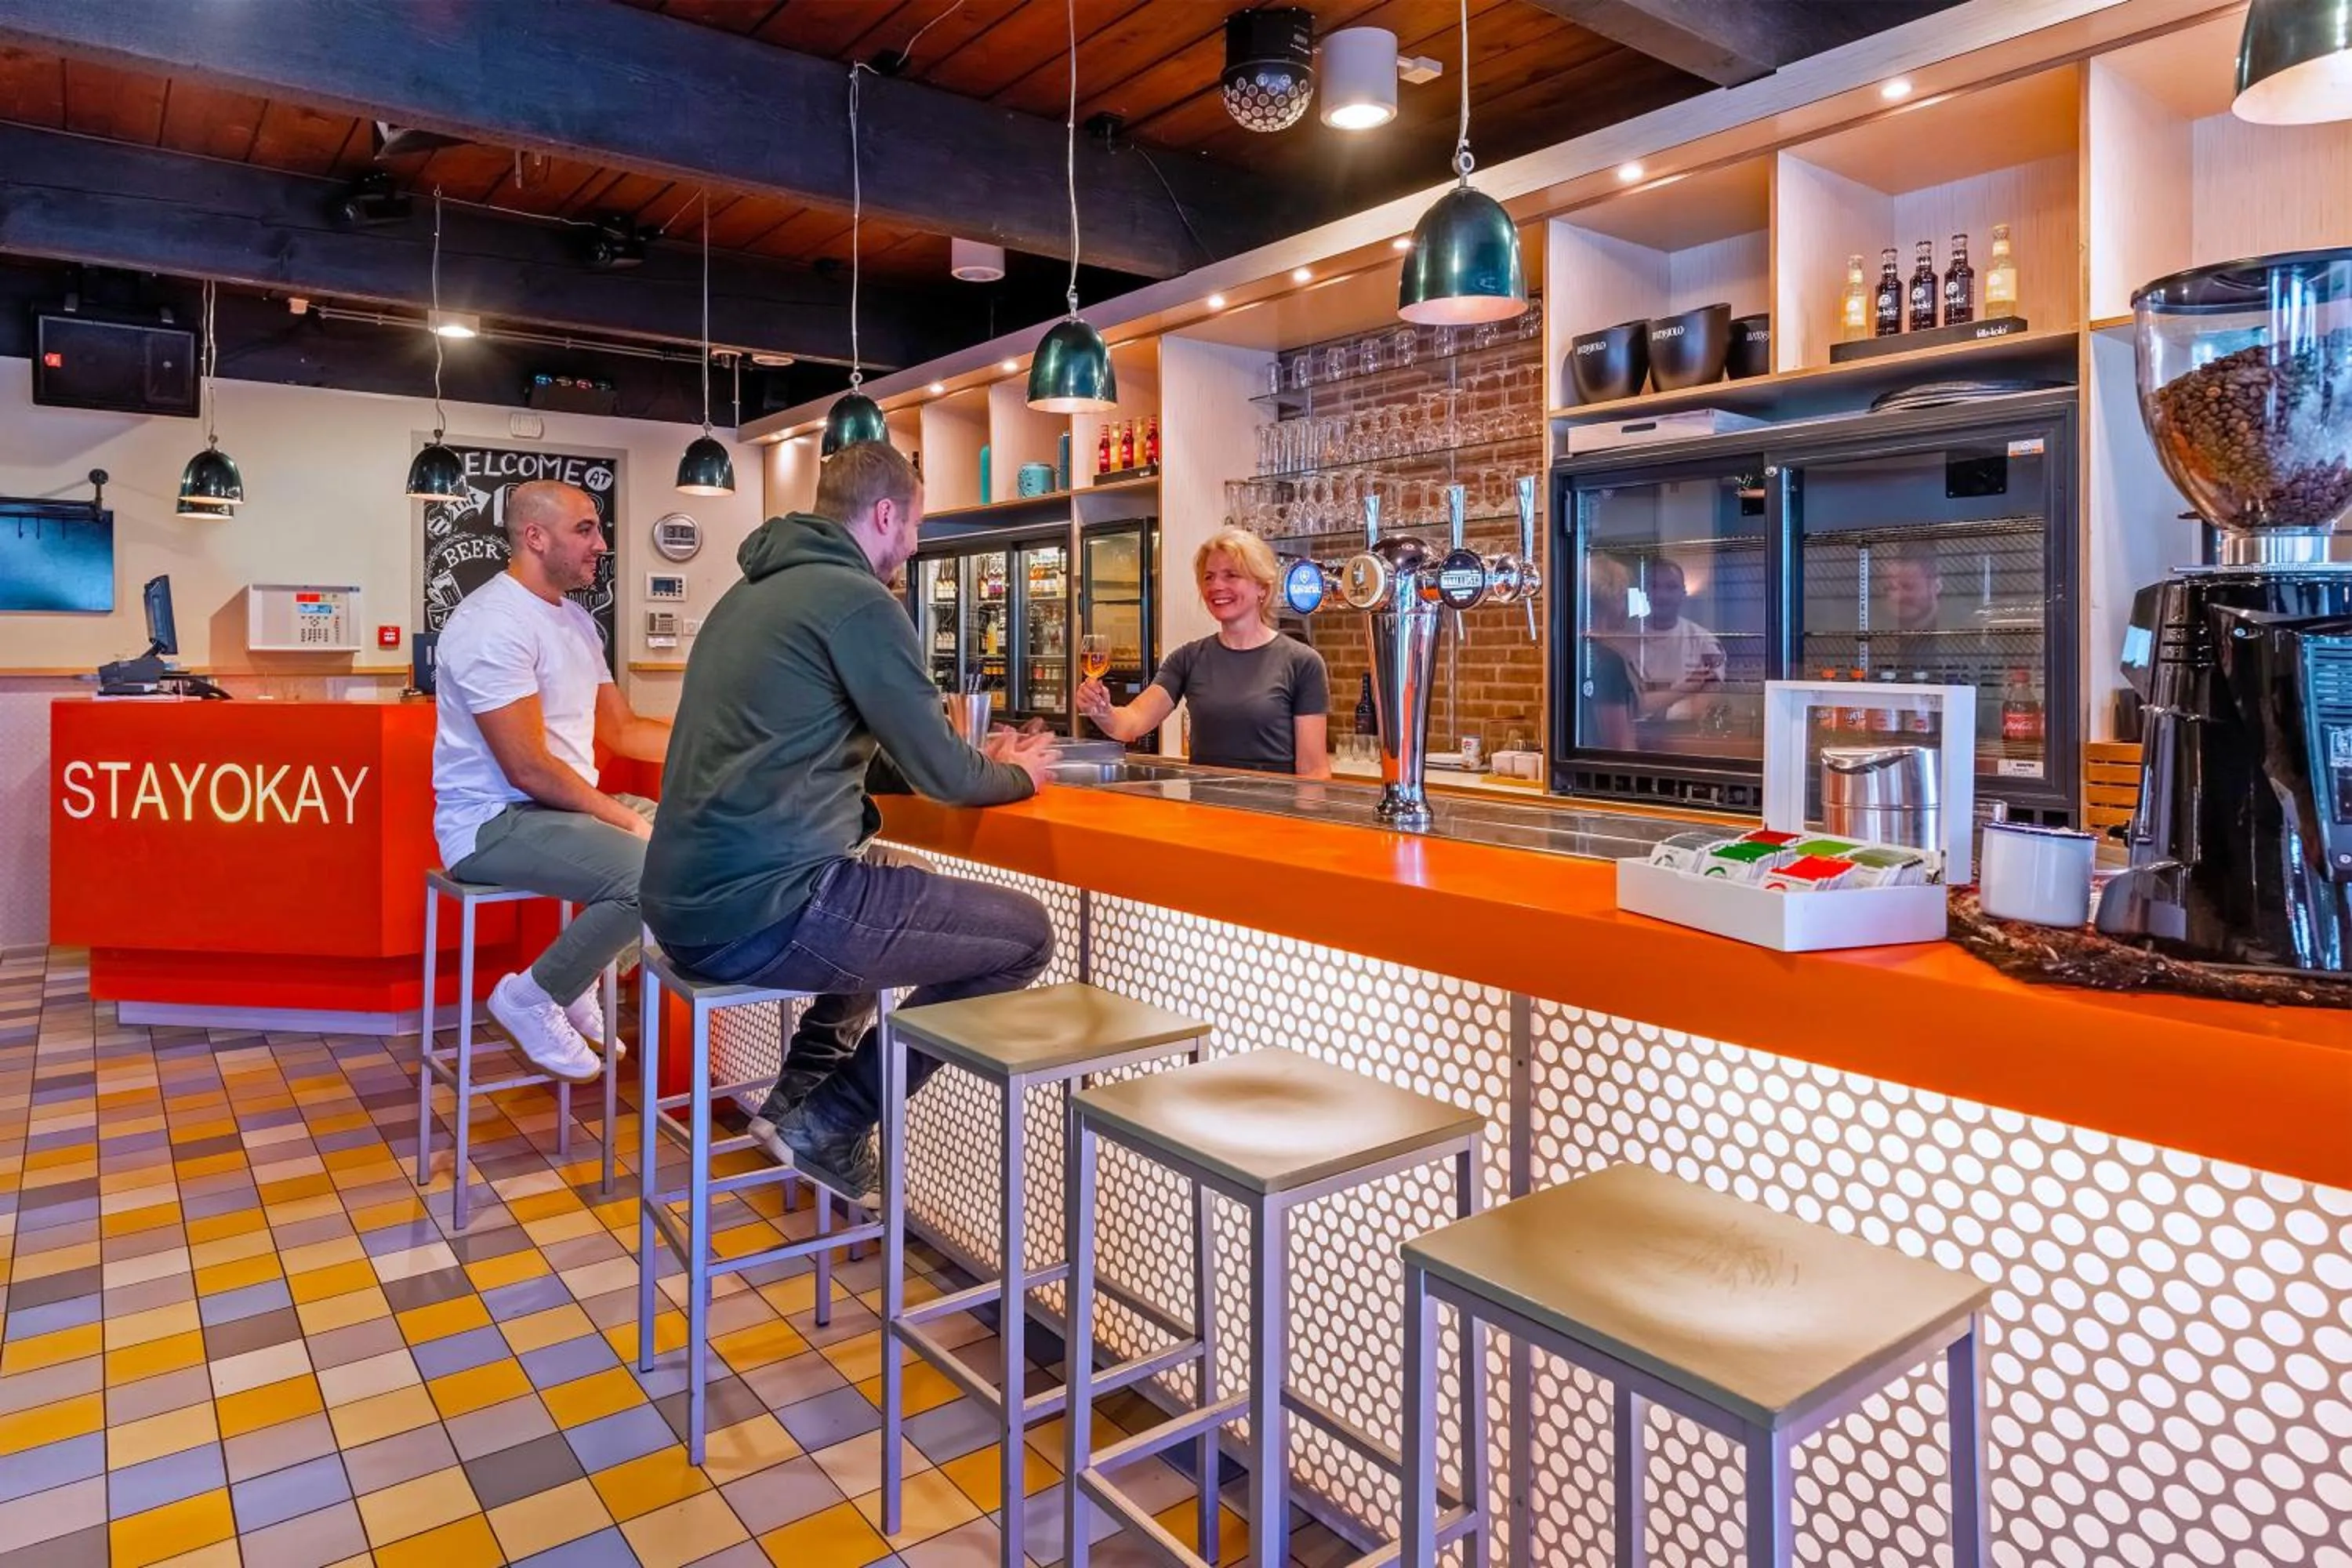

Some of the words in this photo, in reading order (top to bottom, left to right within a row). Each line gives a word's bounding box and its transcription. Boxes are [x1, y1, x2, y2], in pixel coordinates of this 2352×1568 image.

[464, 451, 587, 486] ELCOME
[589, 471, 611, 486] AT
[442, 539, 501, 568] BEER
[62, 760, 369, 824] STAYOKAY
